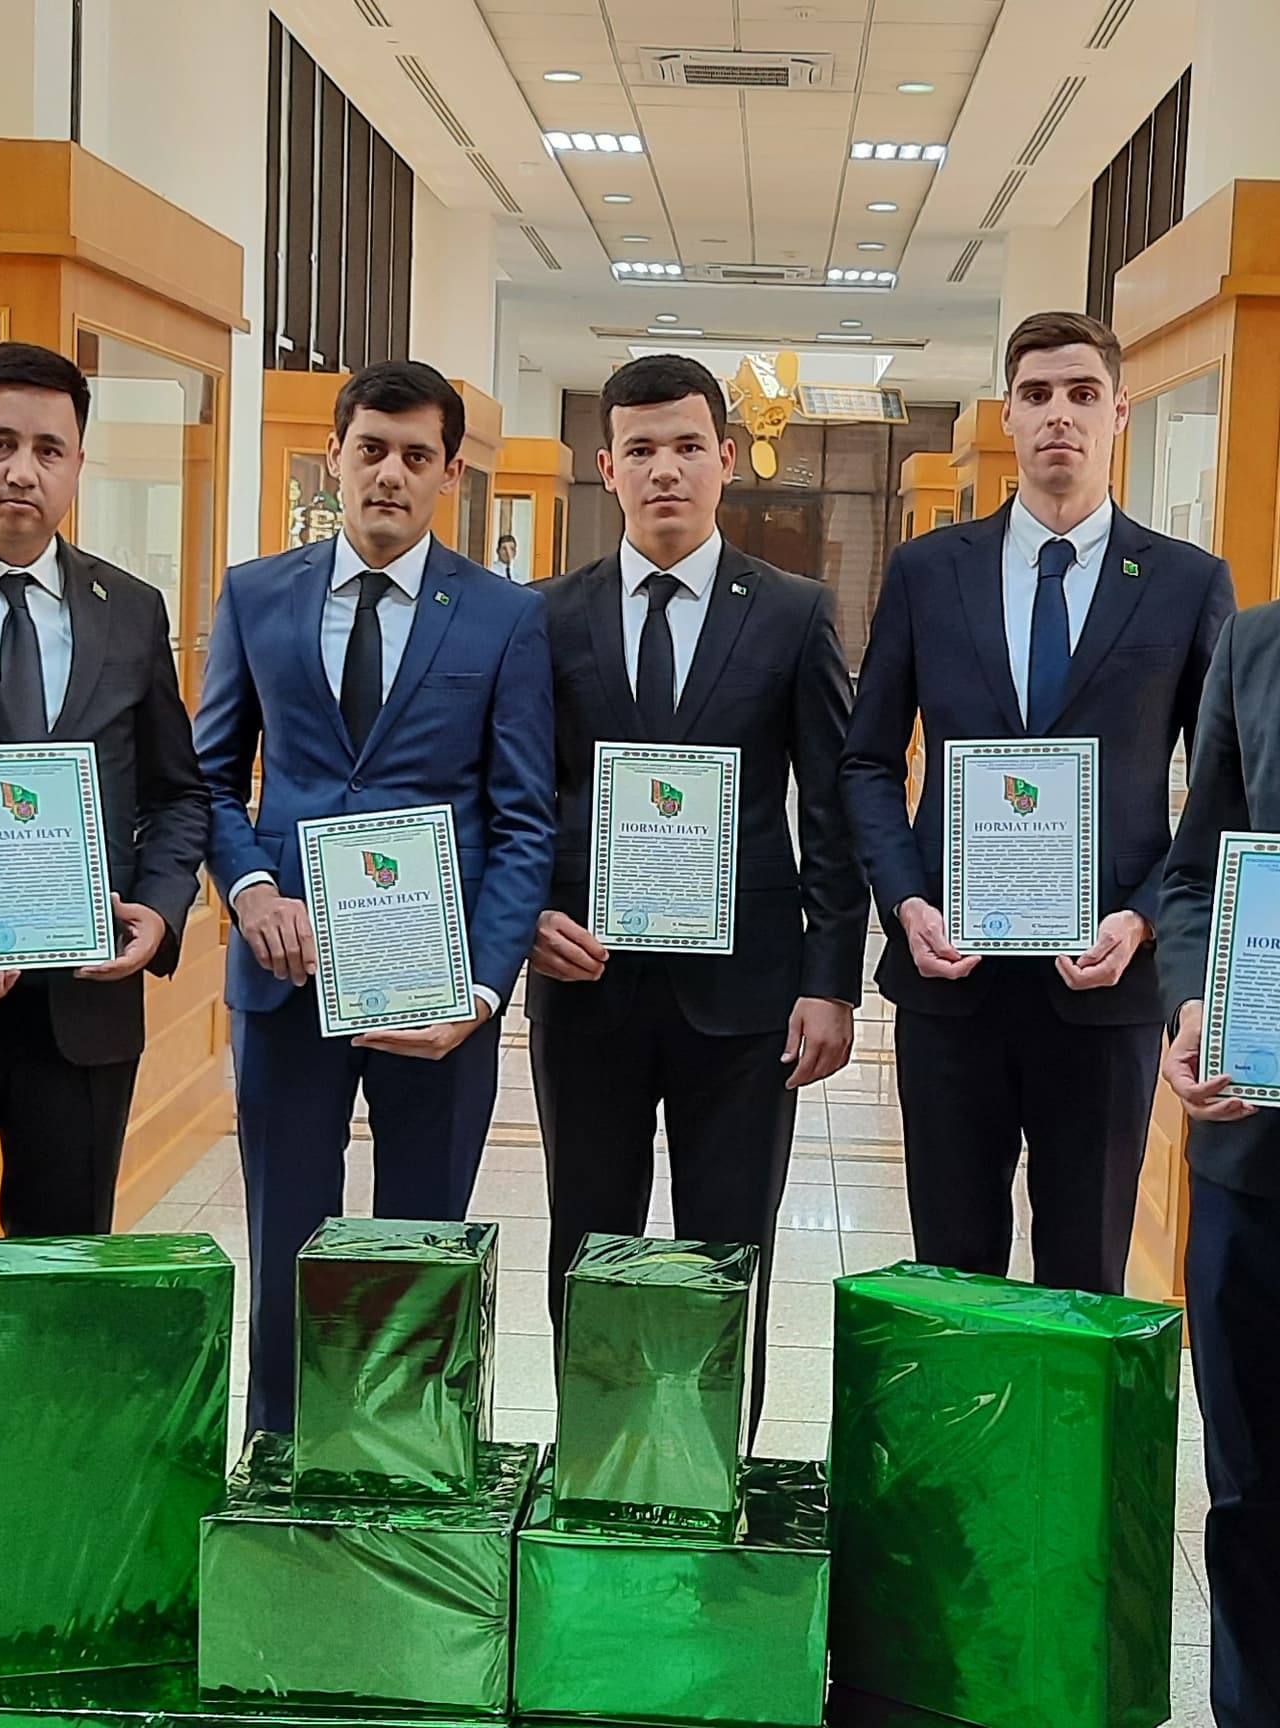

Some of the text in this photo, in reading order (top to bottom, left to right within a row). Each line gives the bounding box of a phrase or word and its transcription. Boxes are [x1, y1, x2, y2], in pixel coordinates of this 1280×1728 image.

[621, 823, 709, 835] HORMAT HATY
[975, 821, 1067, 832] HORMAT HATY
[37, 828, 72, 839] HATY
[338, 891, 431, 910] HORMAT HATY
